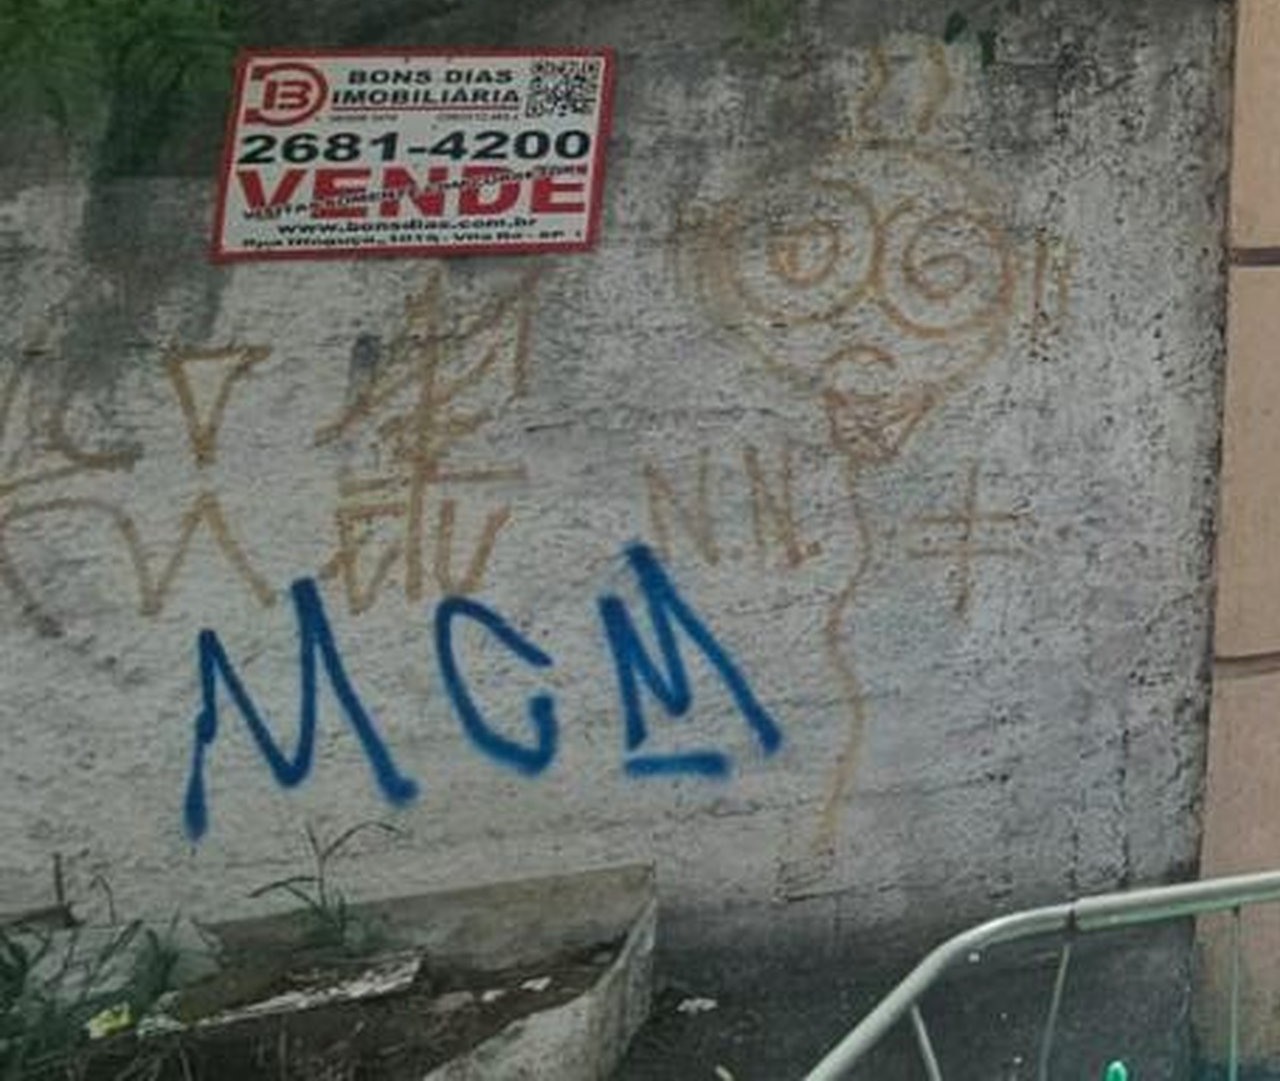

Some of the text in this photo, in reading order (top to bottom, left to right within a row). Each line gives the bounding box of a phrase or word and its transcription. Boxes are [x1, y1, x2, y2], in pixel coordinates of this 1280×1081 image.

[348, 69, 514, 85] BONS DIAS
[237, 130, 591, 164] 2681-4200
[235, 166, 585, 218] VENDE
